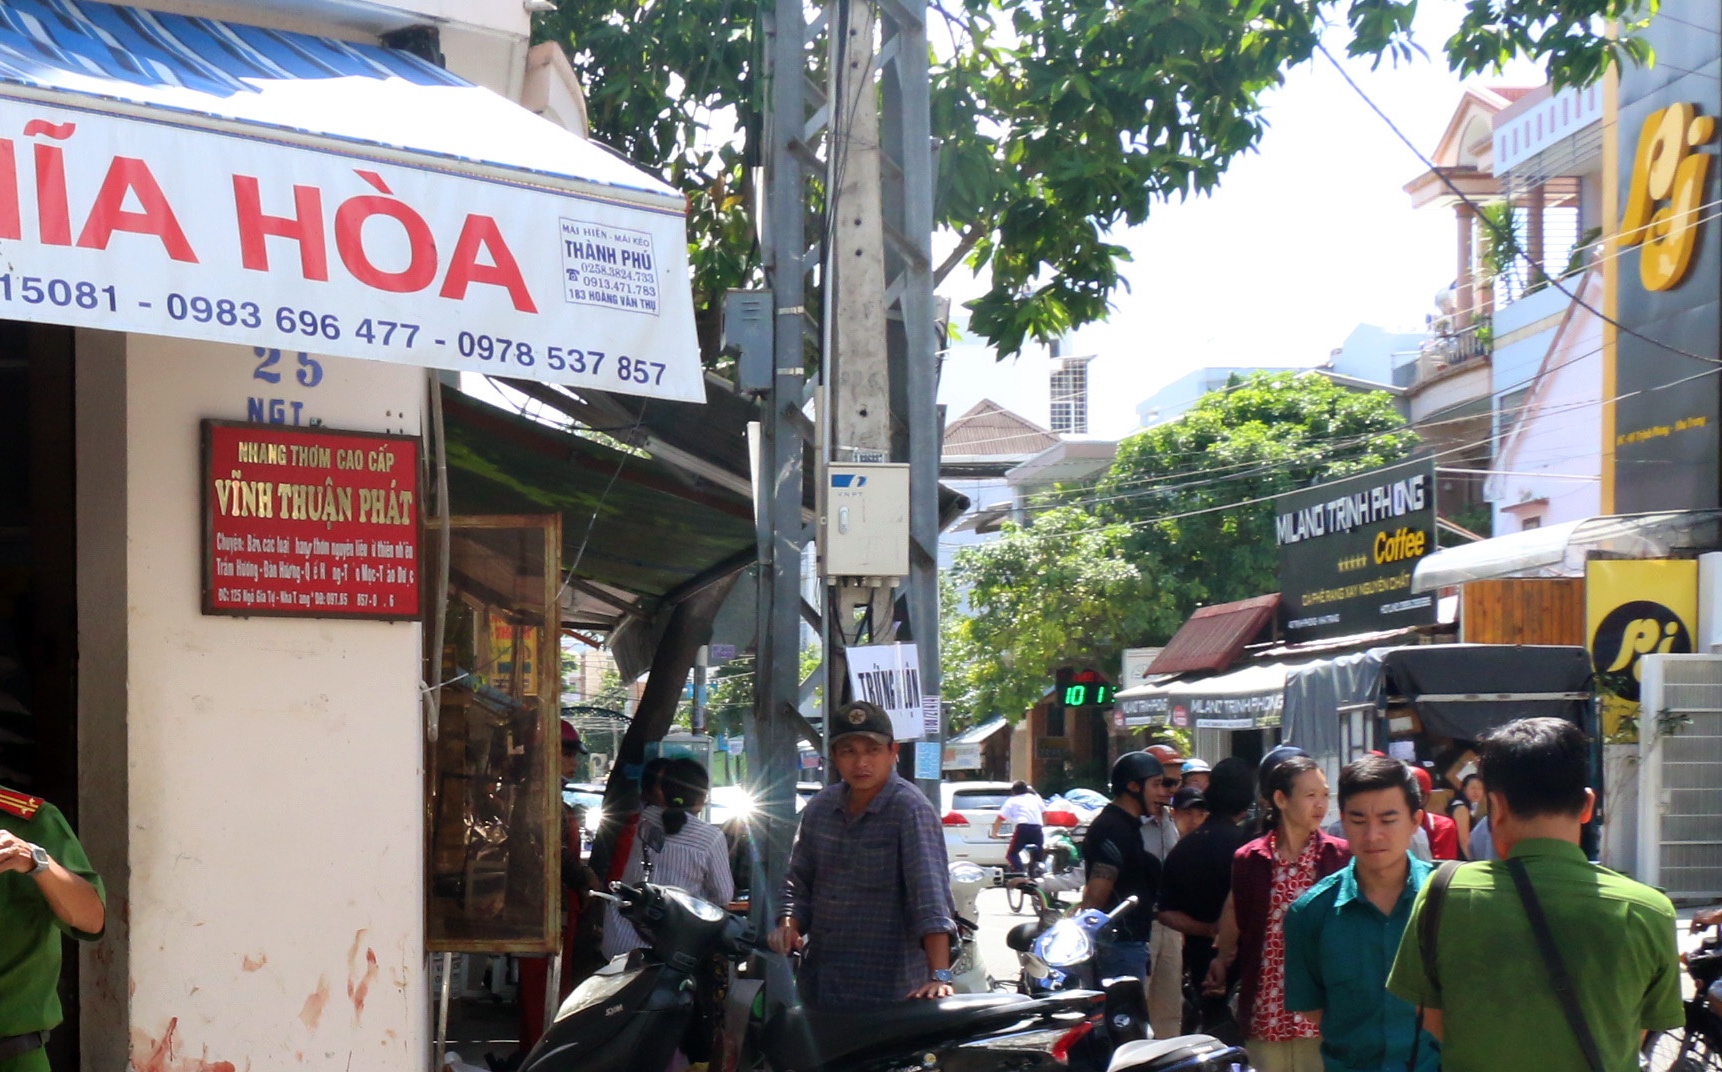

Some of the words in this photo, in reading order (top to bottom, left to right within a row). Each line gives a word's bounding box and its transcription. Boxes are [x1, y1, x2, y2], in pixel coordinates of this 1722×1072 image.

[233, 170, 538, 314] HÒA
[564, 239, 617, 265] THÀNH
[580, 261, 655, 284] 0258.3824.733
[582, 275, 656, 297] 0913.471.783
[167, 293, 262, 330] 0983
[275, 306, 341, 341] 696
[355, 319, 421, 348] 477
[458, 332, 535, 367] 0978
[547, 346, 606, 374] 537
[617, 356, 667, 386] 857
[238, 441, 287, 466] NHANG
[289, 444, 332, 469] THƠM
[336, 449, 364, 471] CAO
[367, 443, 395, 473] CẤP
[214, 469, 274, 519] VĨNH
[277, 476, 353, 530] THUẬN
[358, 479, 414, 525] PHÁT
[1276, 503, 1326, 546] MILANO
[1326, 490, 1370, 535] TRỊNH
[1370, 474, 1425, 522] PHONG
[1374, 526, 1427, 565] Coffee
